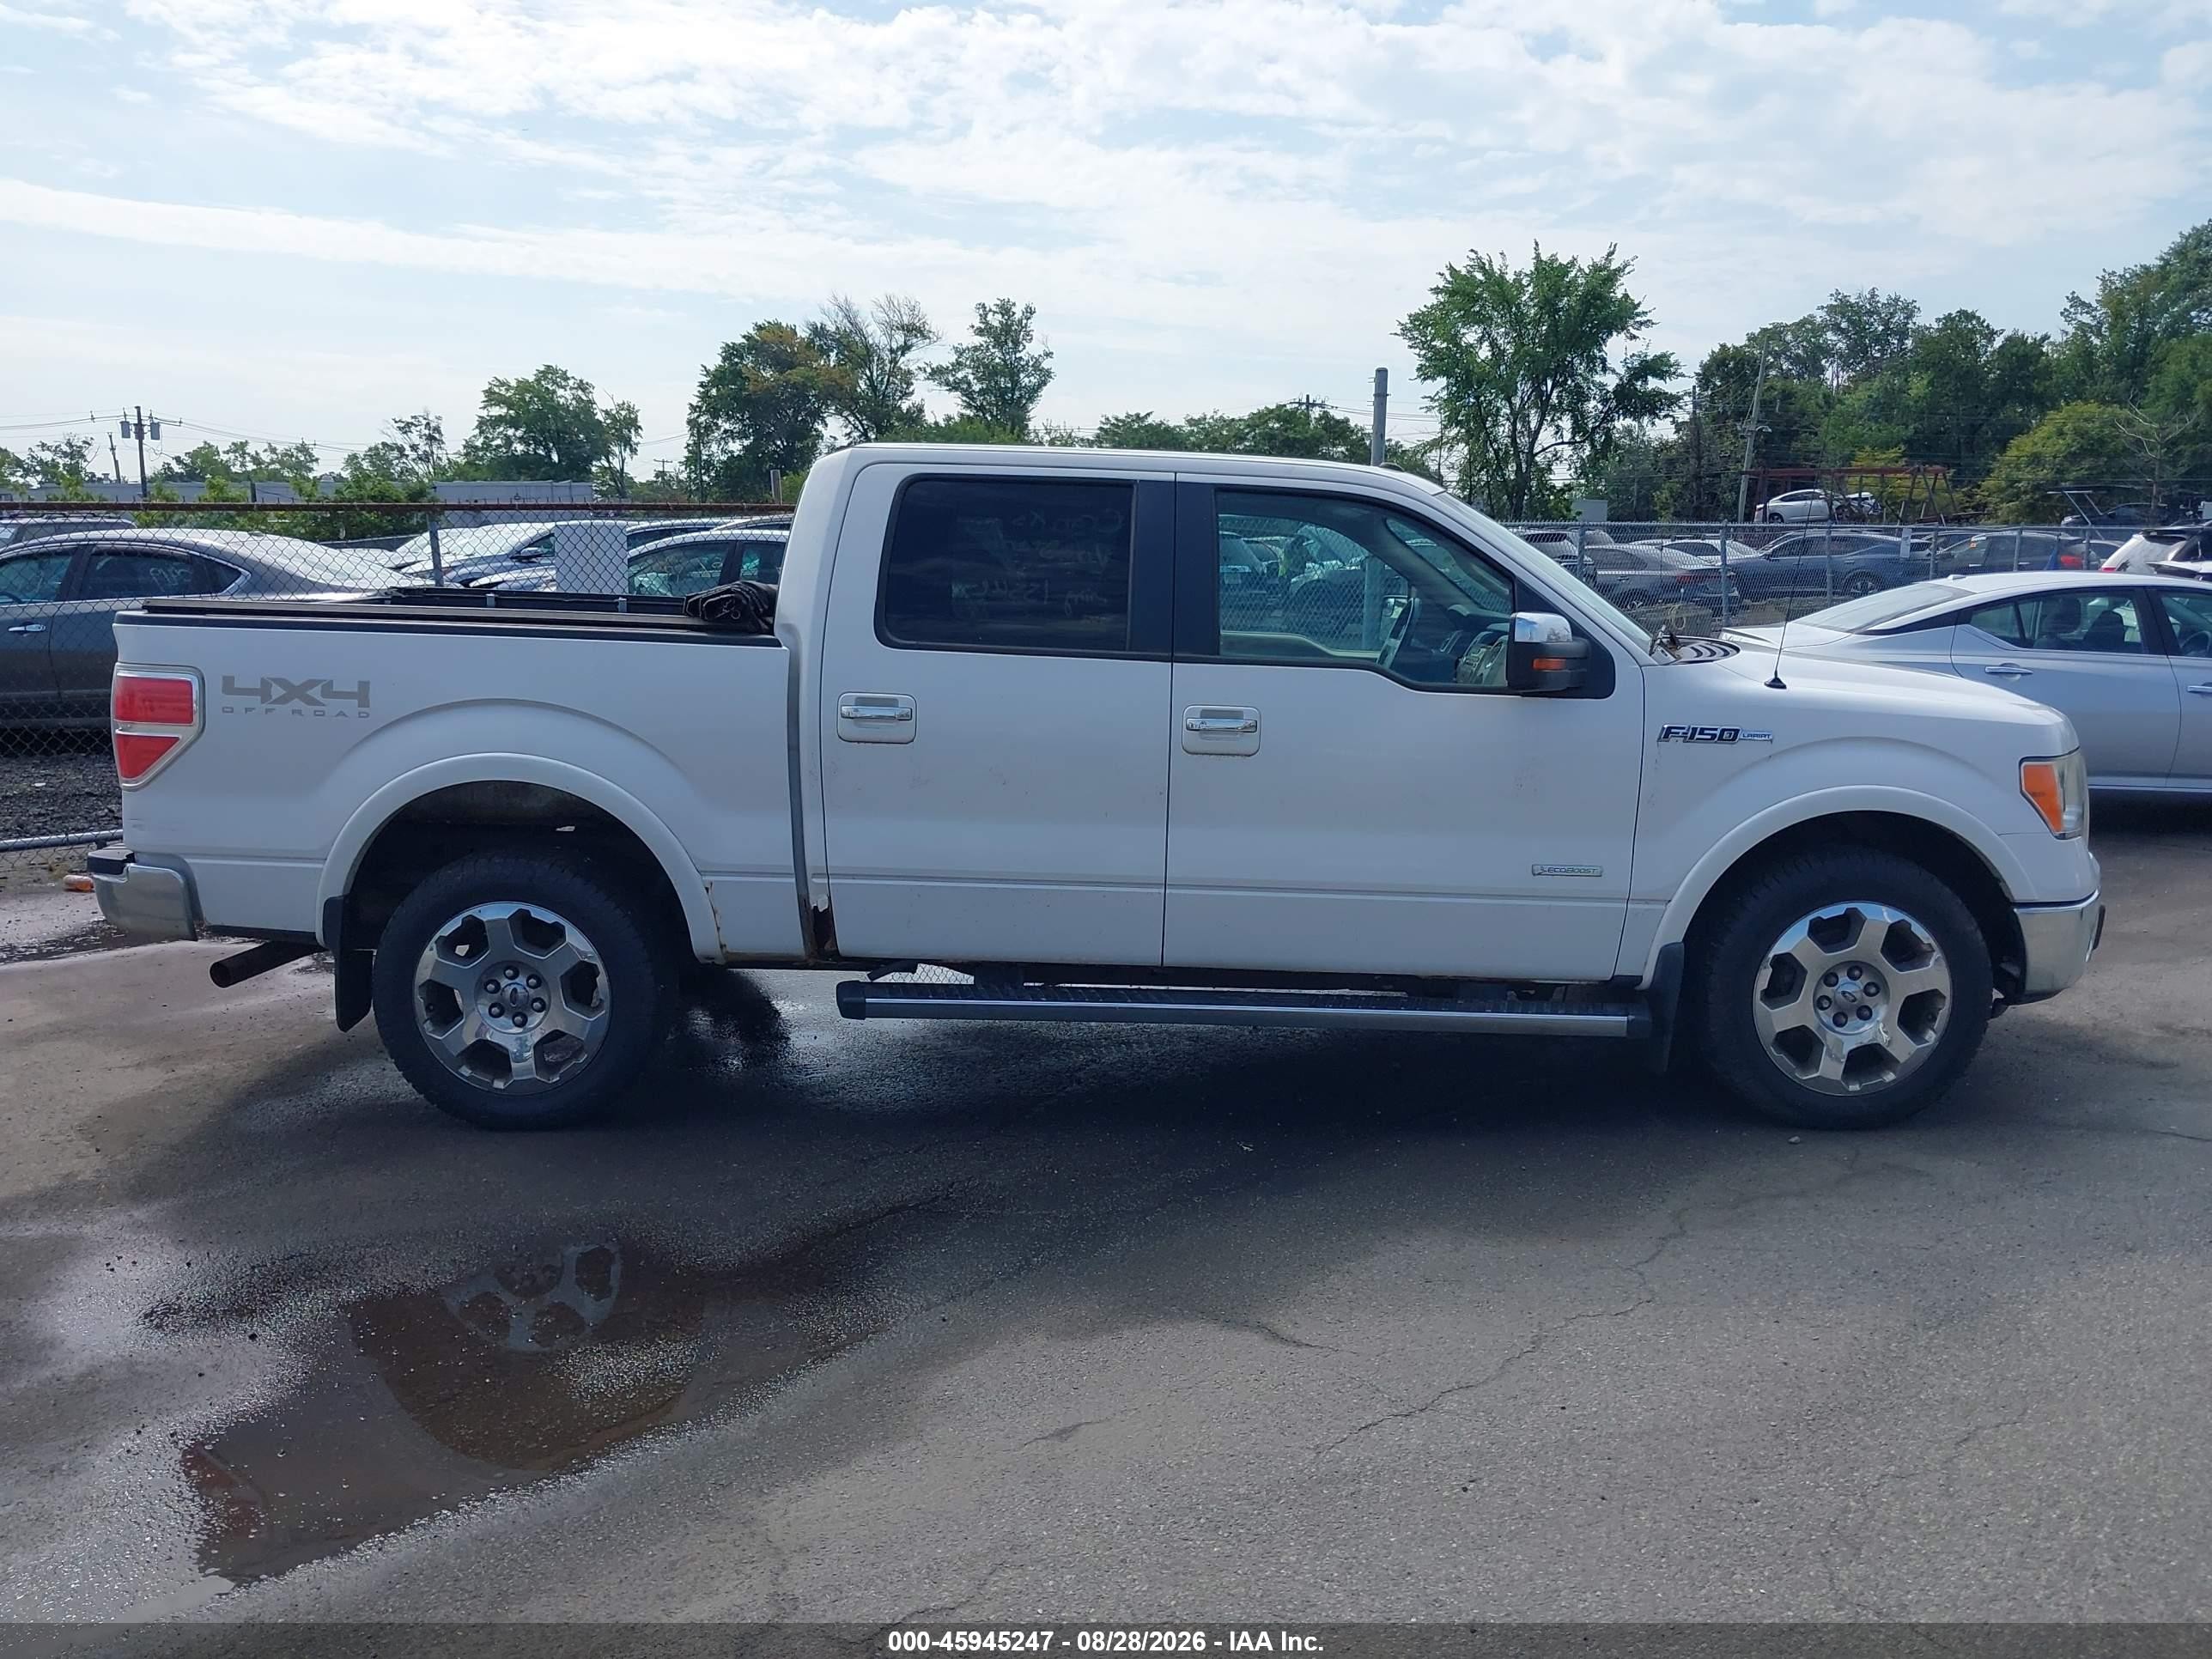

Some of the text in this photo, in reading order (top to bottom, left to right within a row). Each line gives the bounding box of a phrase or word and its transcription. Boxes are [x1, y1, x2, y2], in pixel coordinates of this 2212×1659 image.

[221, 706, 370, 720] OFF ROAD
[1658, 724, 1741, 744] F-150
